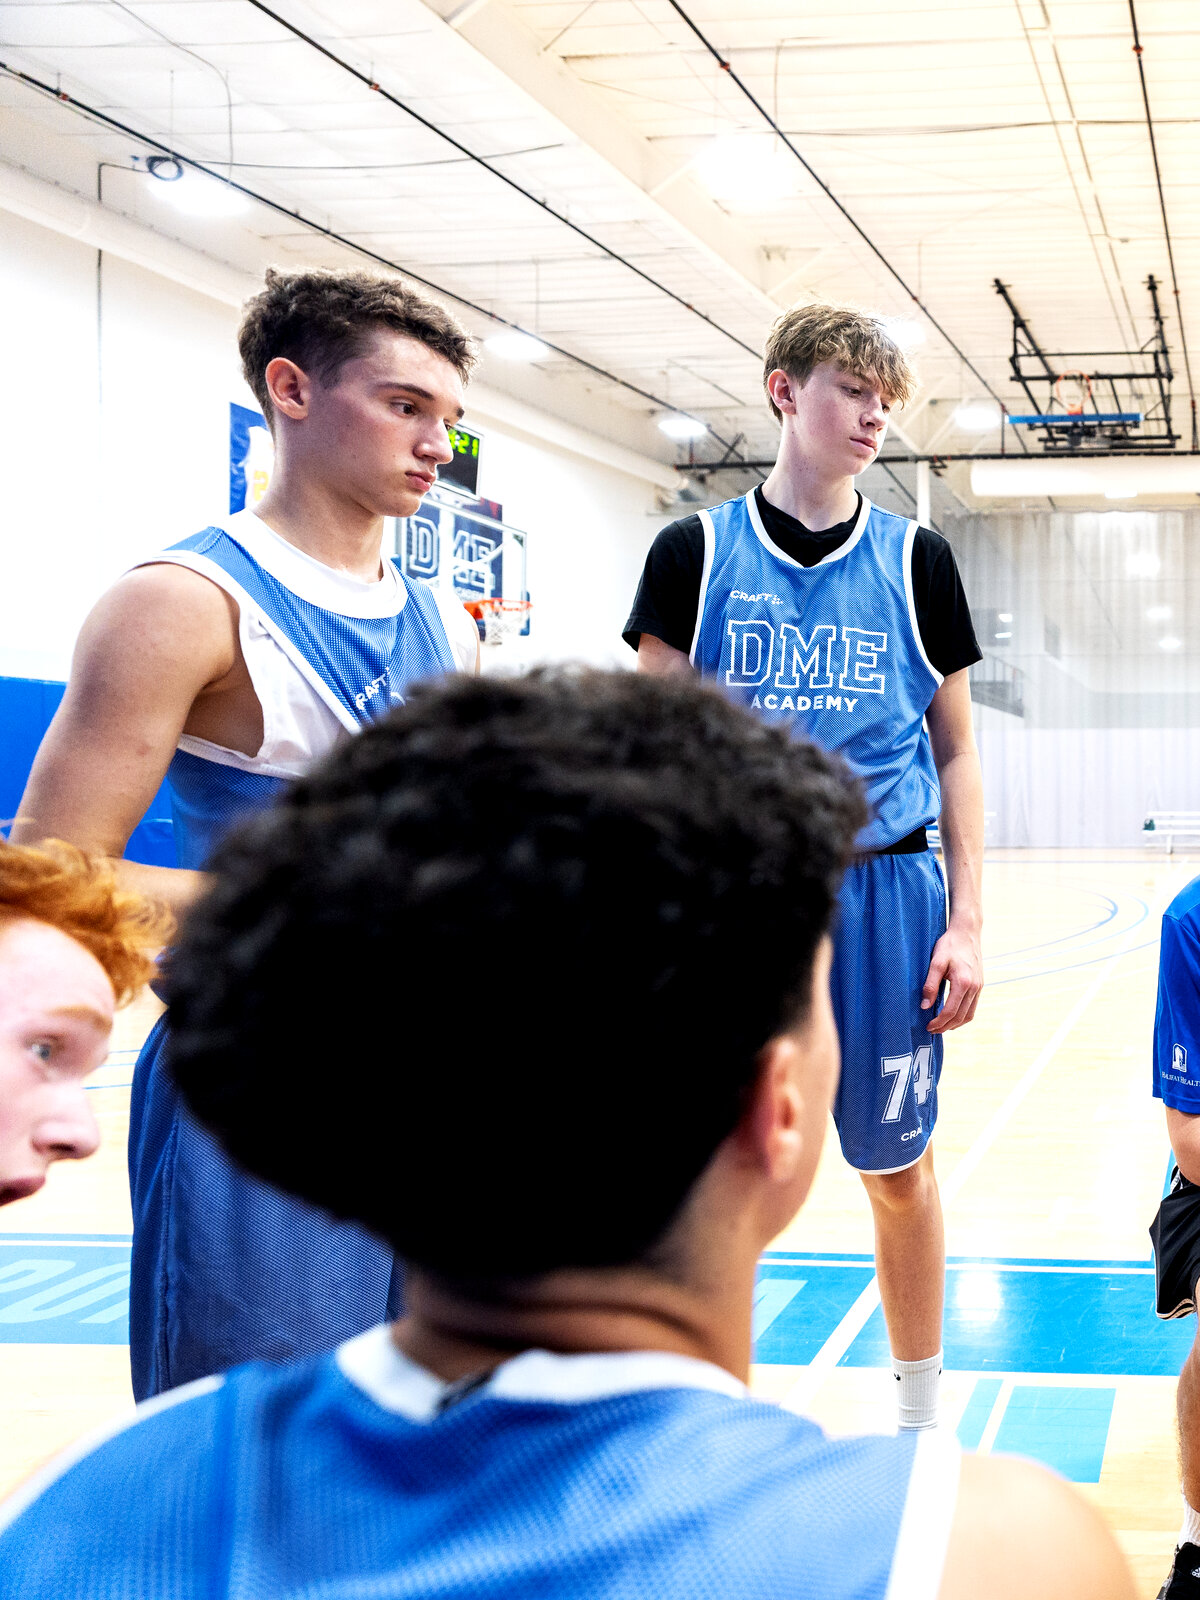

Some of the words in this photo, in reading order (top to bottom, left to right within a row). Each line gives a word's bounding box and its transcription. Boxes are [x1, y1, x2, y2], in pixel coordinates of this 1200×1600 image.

[730, 590, 772, 603] CRAFT
[726, 619, 888, 694] DME
[355, 673, 387, 711] RAFT
[750, 694, 859, 713] ACADEMY
[881, 1044, 934, 1124] 74
